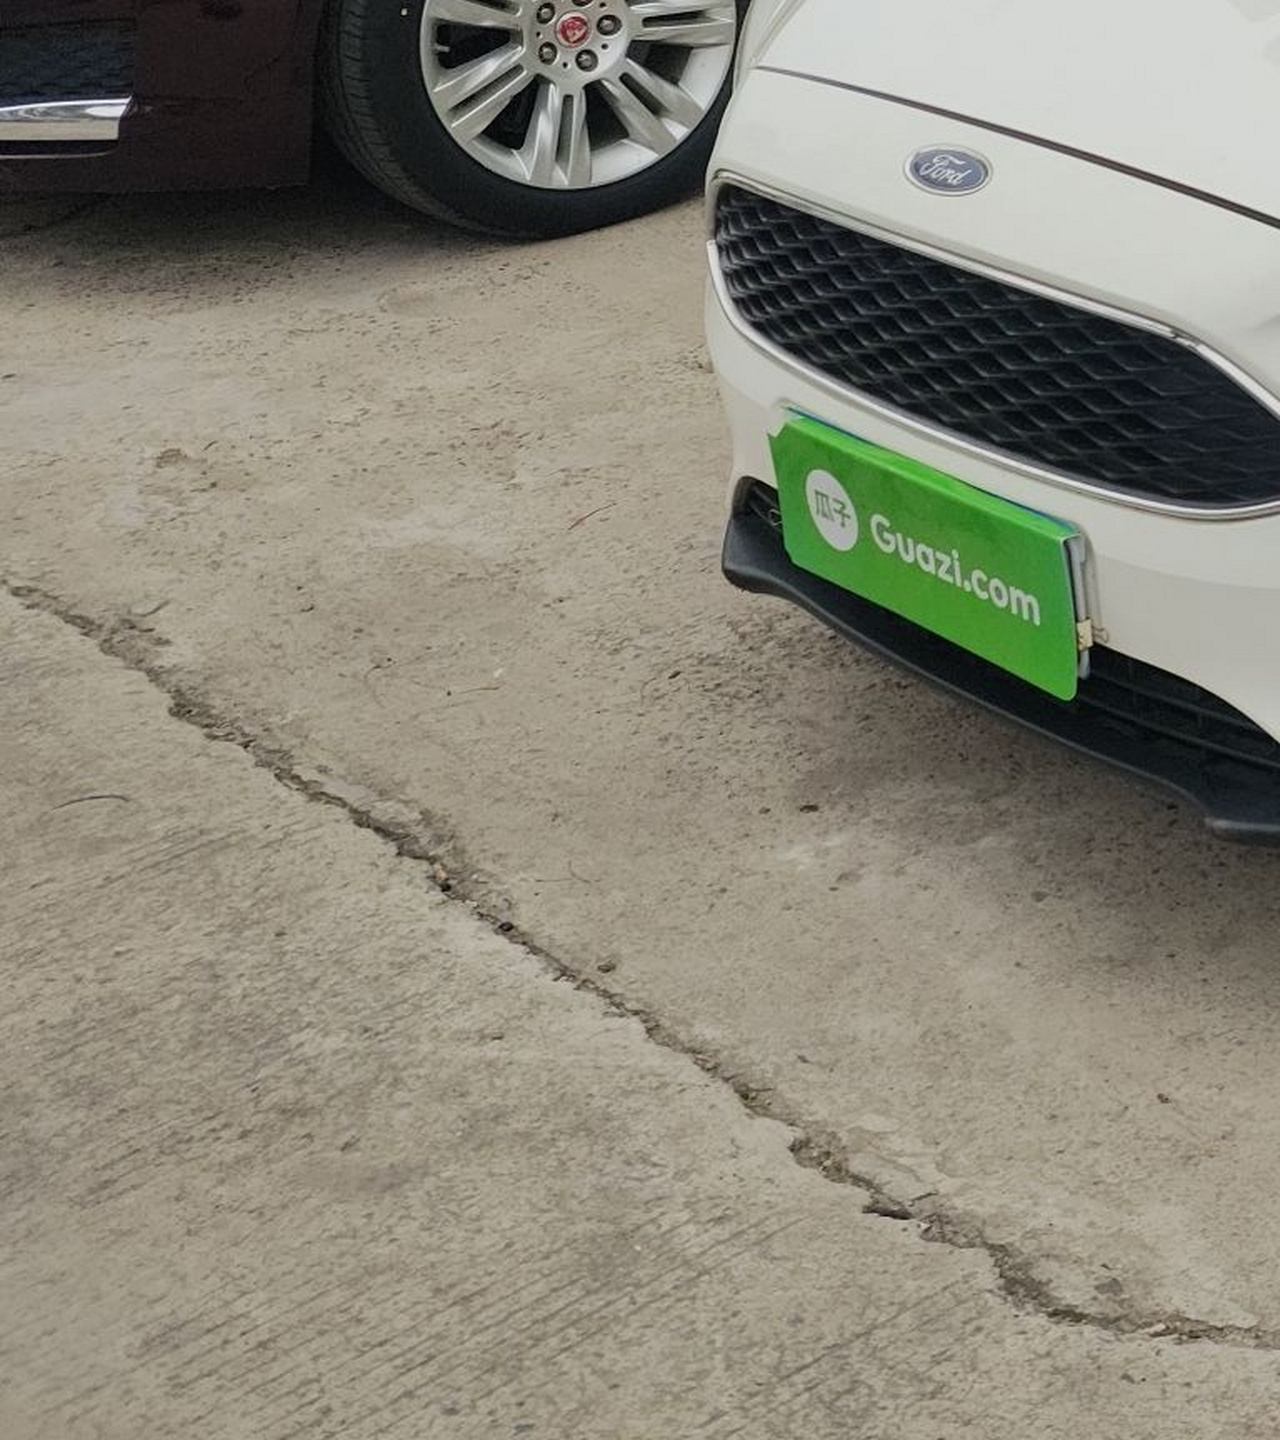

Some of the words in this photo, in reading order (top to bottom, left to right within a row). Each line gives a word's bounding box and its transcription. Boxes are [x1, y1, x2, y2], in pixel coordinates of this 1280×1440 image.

[919, 154, 972, 186] Ford
[814, 490, 852, 529] 瓜子
[870, 513, 1041, 627] Guazi.com
